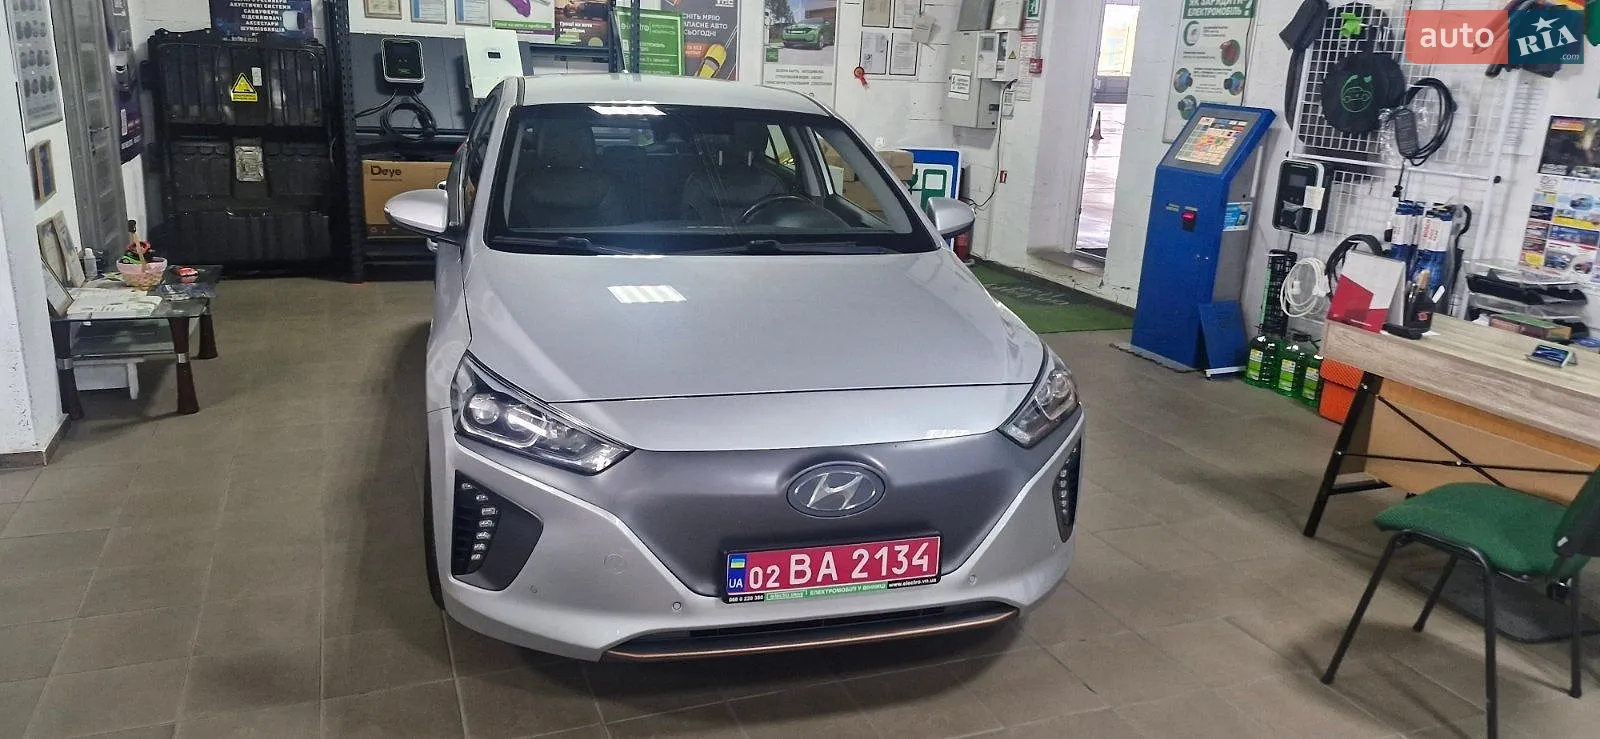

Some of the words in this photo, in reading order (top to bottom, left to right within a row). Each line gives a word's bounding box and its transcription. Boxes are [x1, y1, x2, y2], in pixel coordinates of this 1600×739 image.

[370, 165, 402, 178] Deye
[749, 565, 780, 590] 02
[789, 552, 839, 585] BA
[851, 542, 929, 579] 2134
[728, 577, 743, 589] UA
